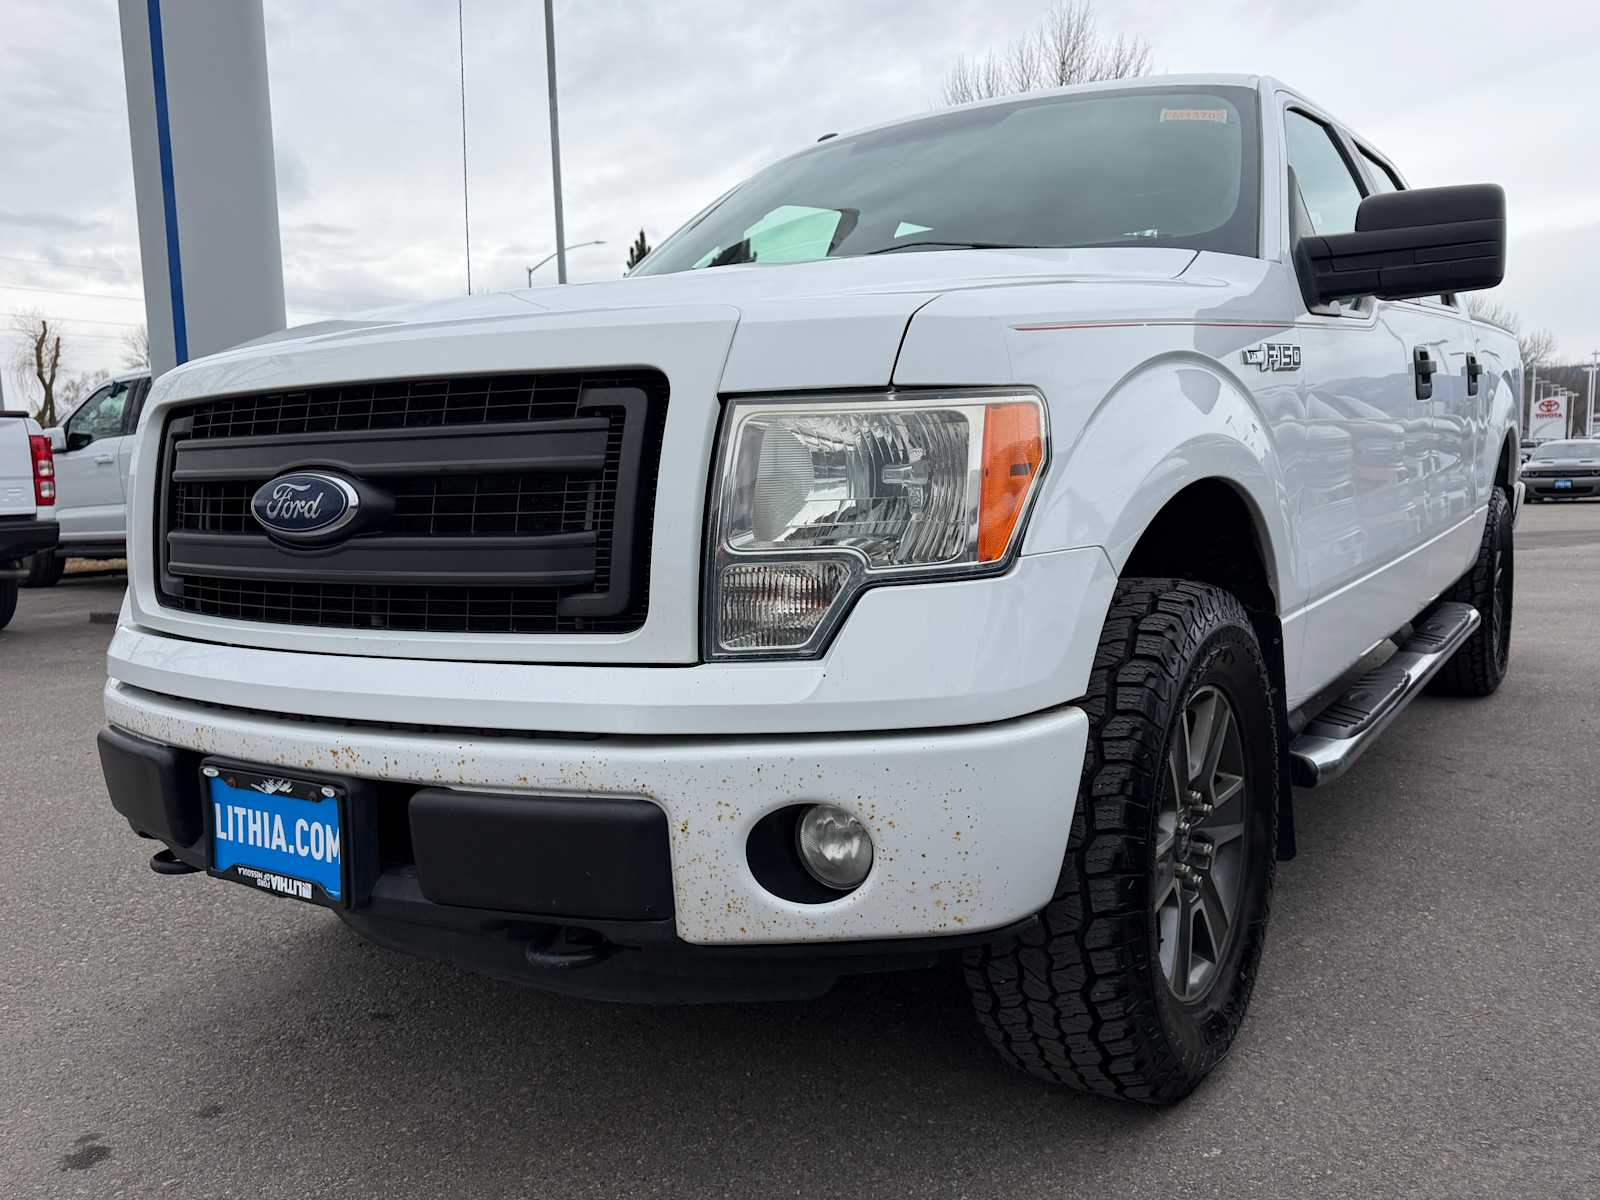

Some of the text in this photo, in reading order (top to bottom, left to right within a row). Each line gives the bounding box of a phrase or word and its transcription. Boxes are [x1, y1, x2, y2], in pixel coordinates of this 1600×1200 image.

[1261, 342, 1302, 370] F-150
[265, 483, 324, 519] Ford
[214, 803, 341, 865] LITHIA.COM
